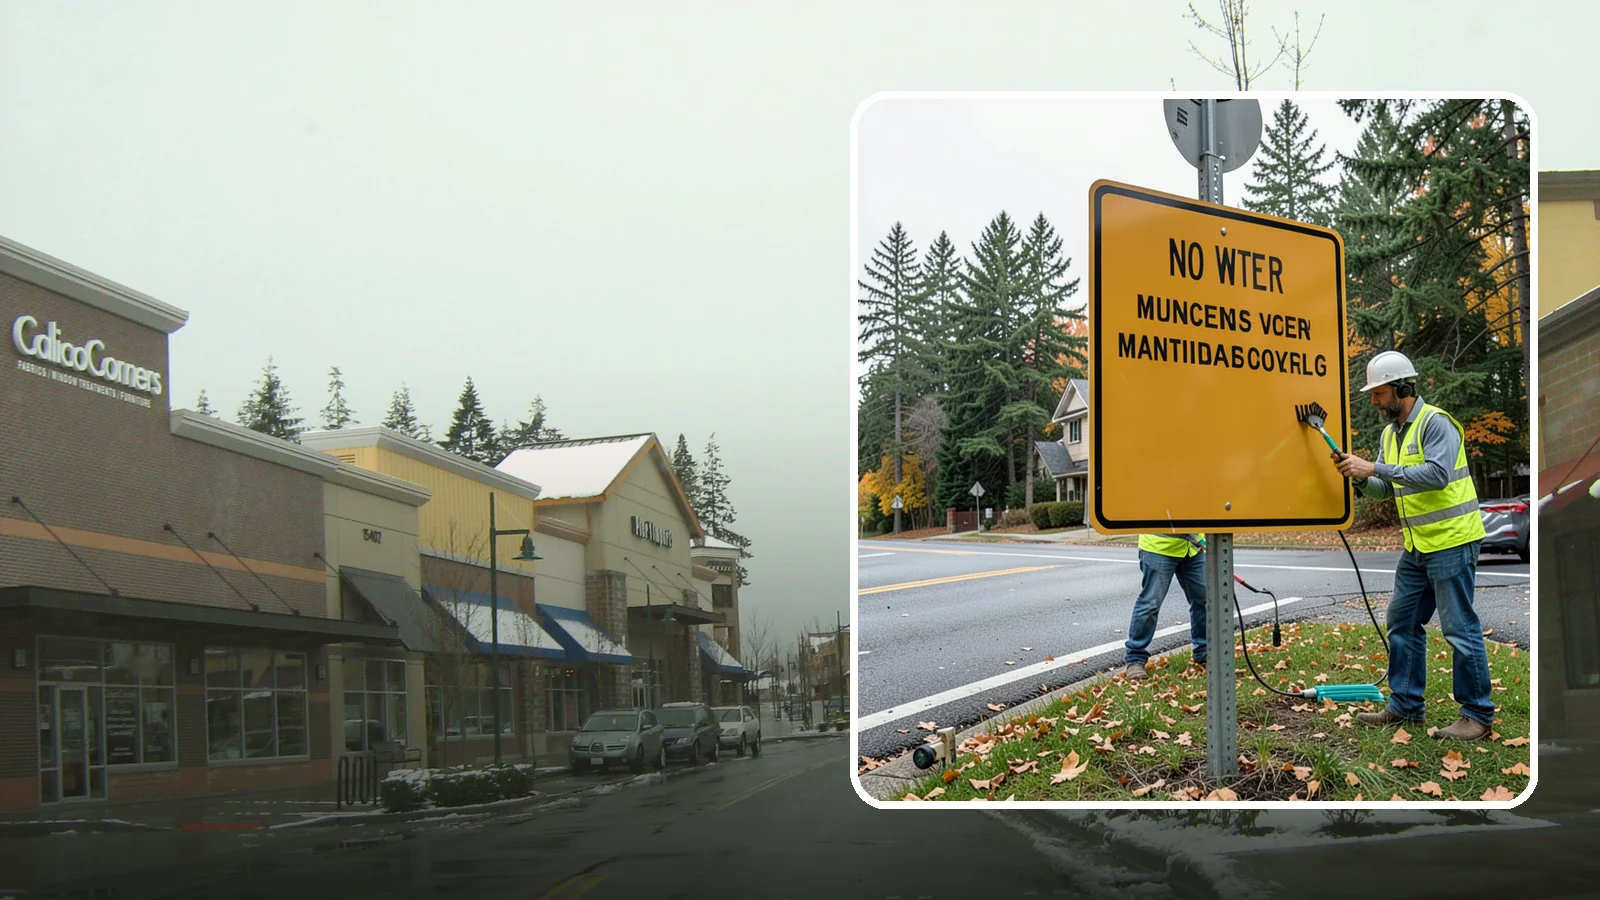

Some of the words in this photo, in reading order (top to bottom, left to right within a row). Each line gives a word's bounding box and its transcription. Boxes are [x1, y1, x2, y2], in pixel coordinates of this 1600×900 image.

[1169, 238, 1204, 281] NO
[1215, 245, 1284, 294] WTER
[1137, 294, 1251, 333] MUNCENS
[17, 360, 47, 378] FABRICS
[51, 370, 78, 386] WINDOW
[79, 378, 117, 398] TREATMENTS
